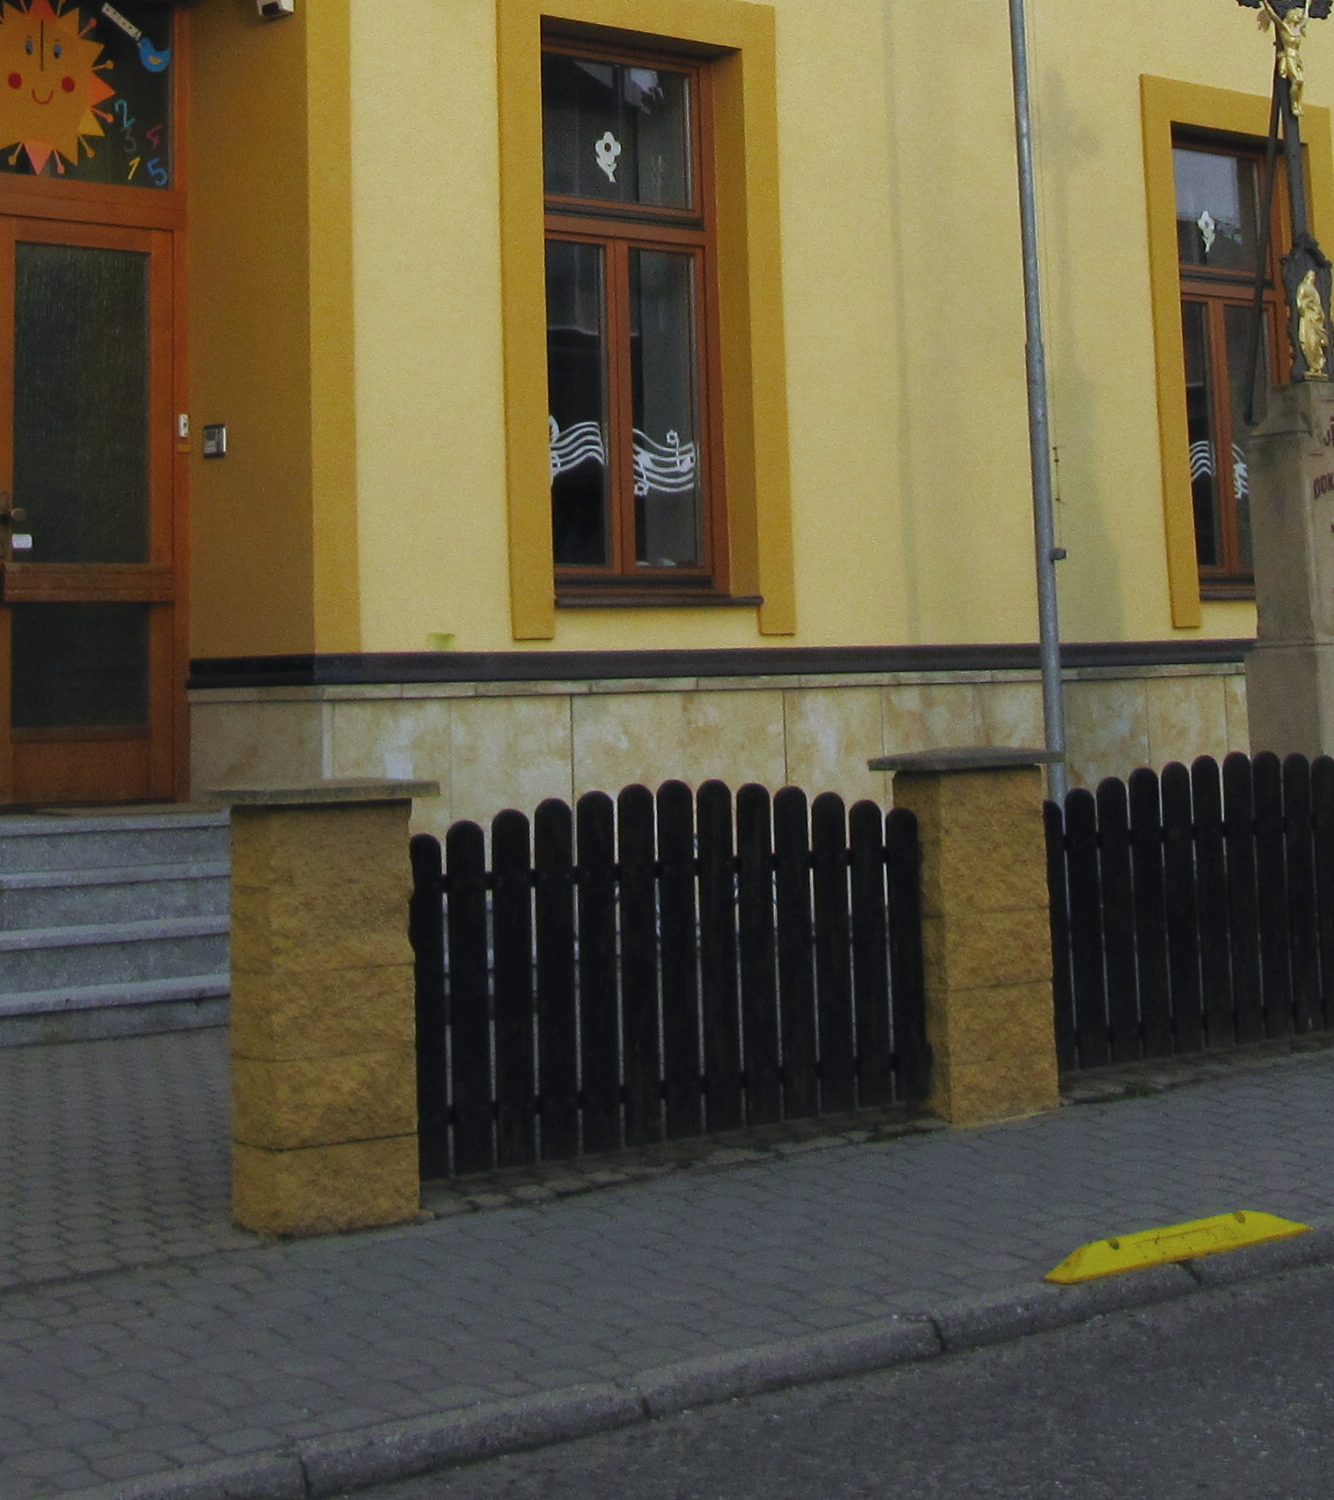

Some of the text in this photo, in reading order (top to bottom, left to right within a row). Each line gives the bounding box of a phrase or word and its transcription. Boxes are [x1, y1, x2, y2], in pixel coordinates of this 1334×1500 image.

[114, 99, 136, 129] 2
[128, 155, 142, 181] 1
[146, 156, 169, 187] 5
